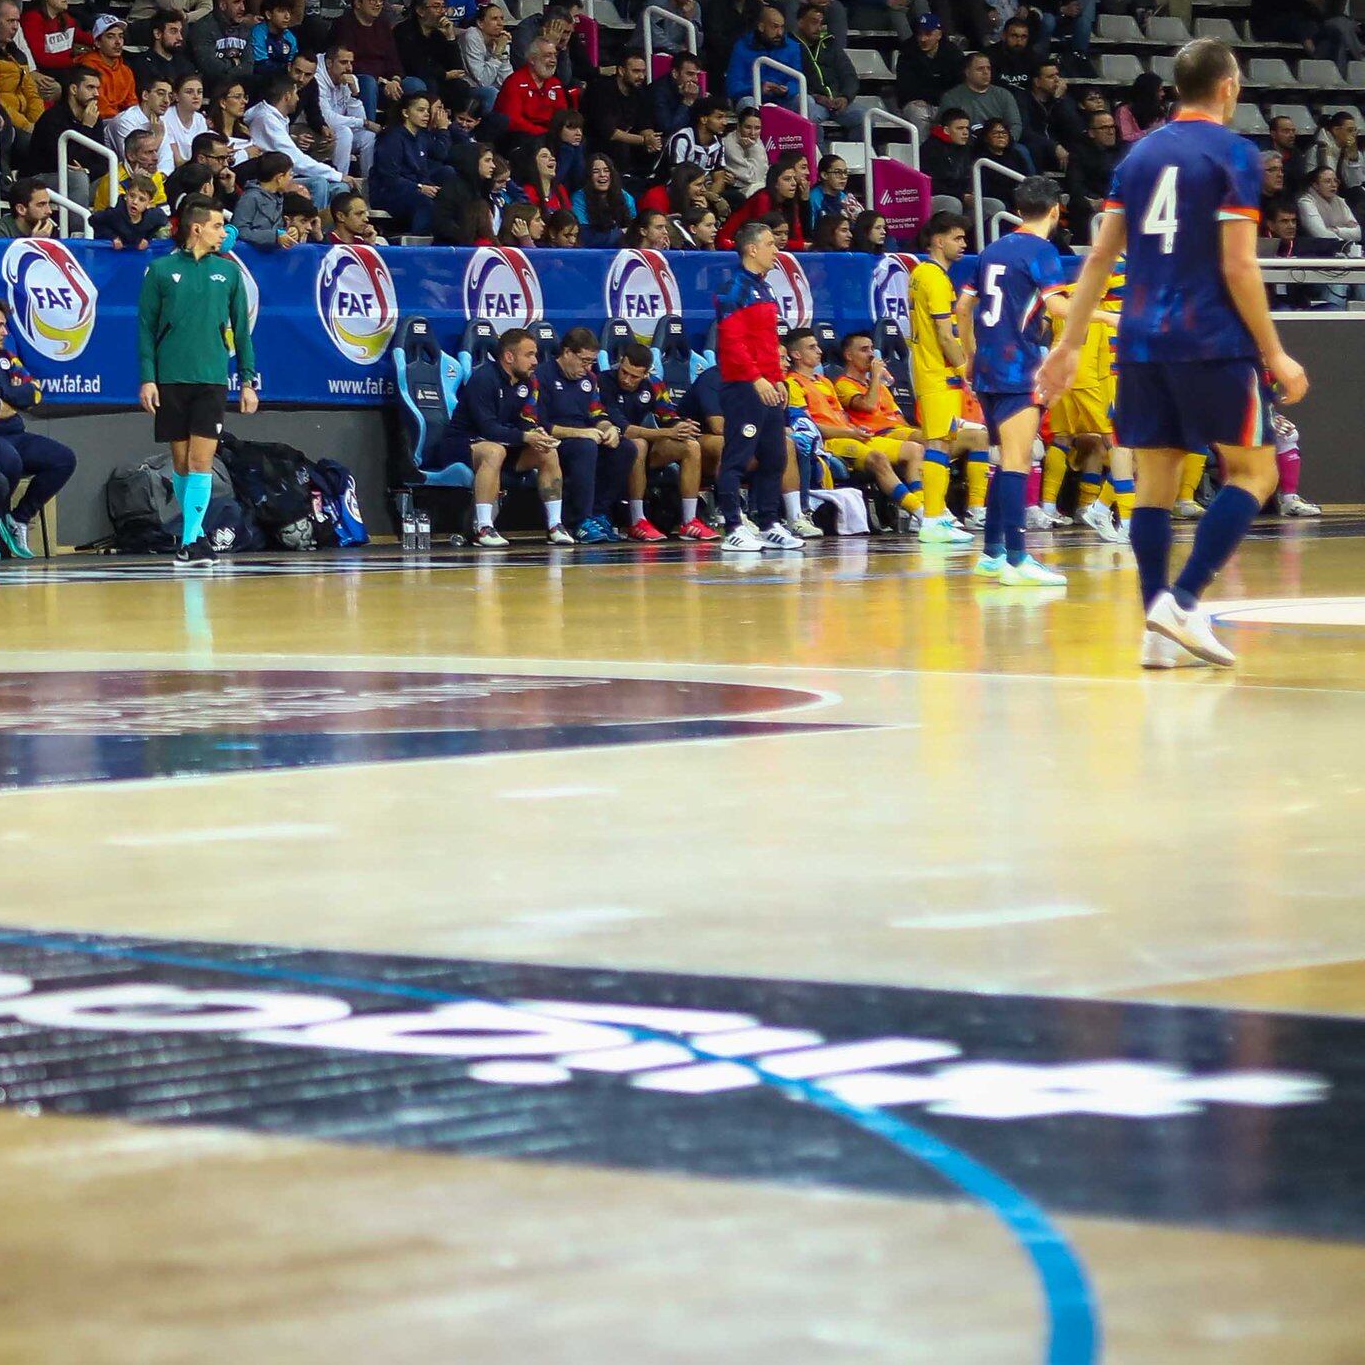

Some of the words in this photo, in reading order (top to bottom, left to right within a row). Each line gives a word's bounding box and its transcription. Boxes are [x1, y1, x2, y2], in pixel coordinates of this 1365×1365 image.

[1143, 166, 1179, 255] 4
[30, 287, 74, 310] FAF
[338, 291, 374, 317] FAF
[485, 293, 522, 318] FAF
[625, 293, 660, 318] FAF
[983, 264, 1008, 327] 5
[885, 297, 908, 320] FA
